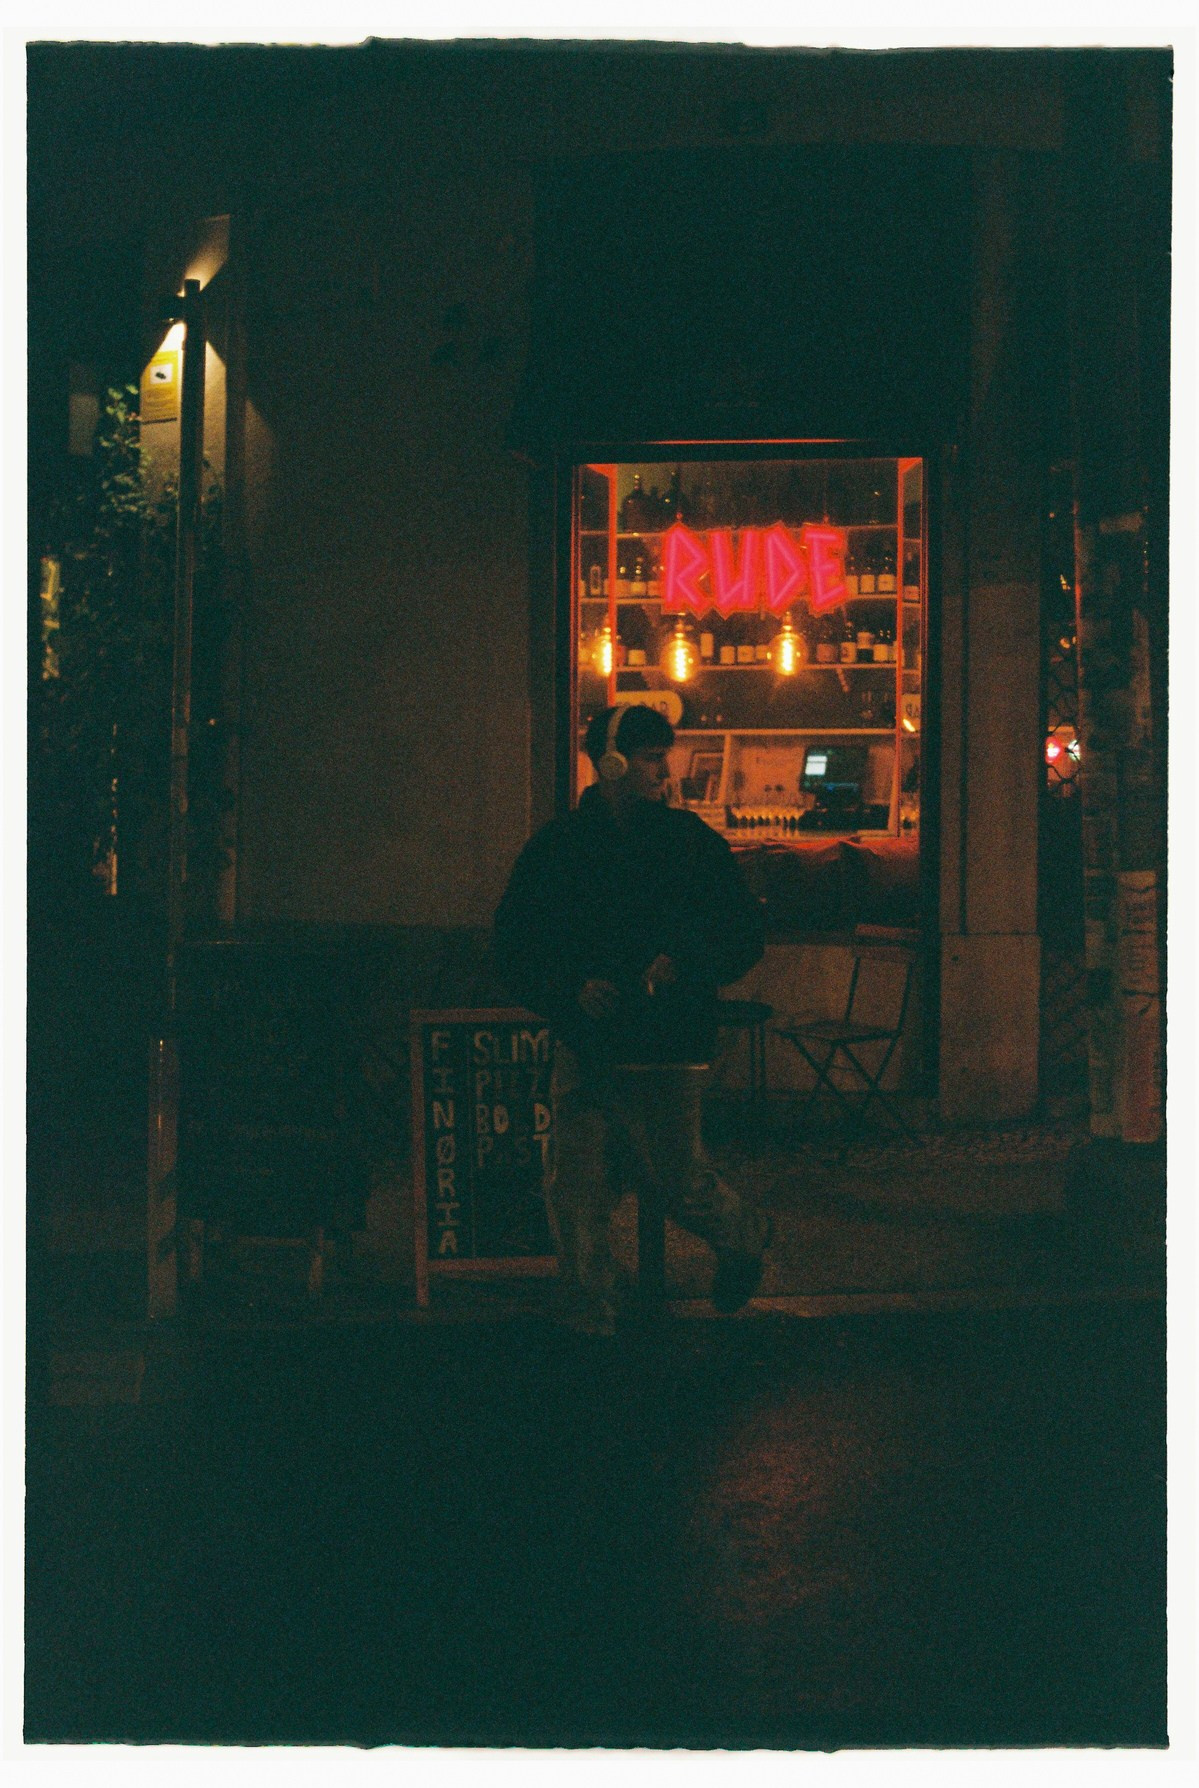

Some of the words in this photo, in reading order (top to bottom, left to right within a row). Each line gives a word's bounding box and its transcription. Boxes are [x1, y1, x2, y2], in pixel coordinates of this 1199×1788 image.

[663, 525, 849, 615] RUDE
[473, 1029, 550, 1065] SLIM
[475, 1101, 551, 1134] BOD
